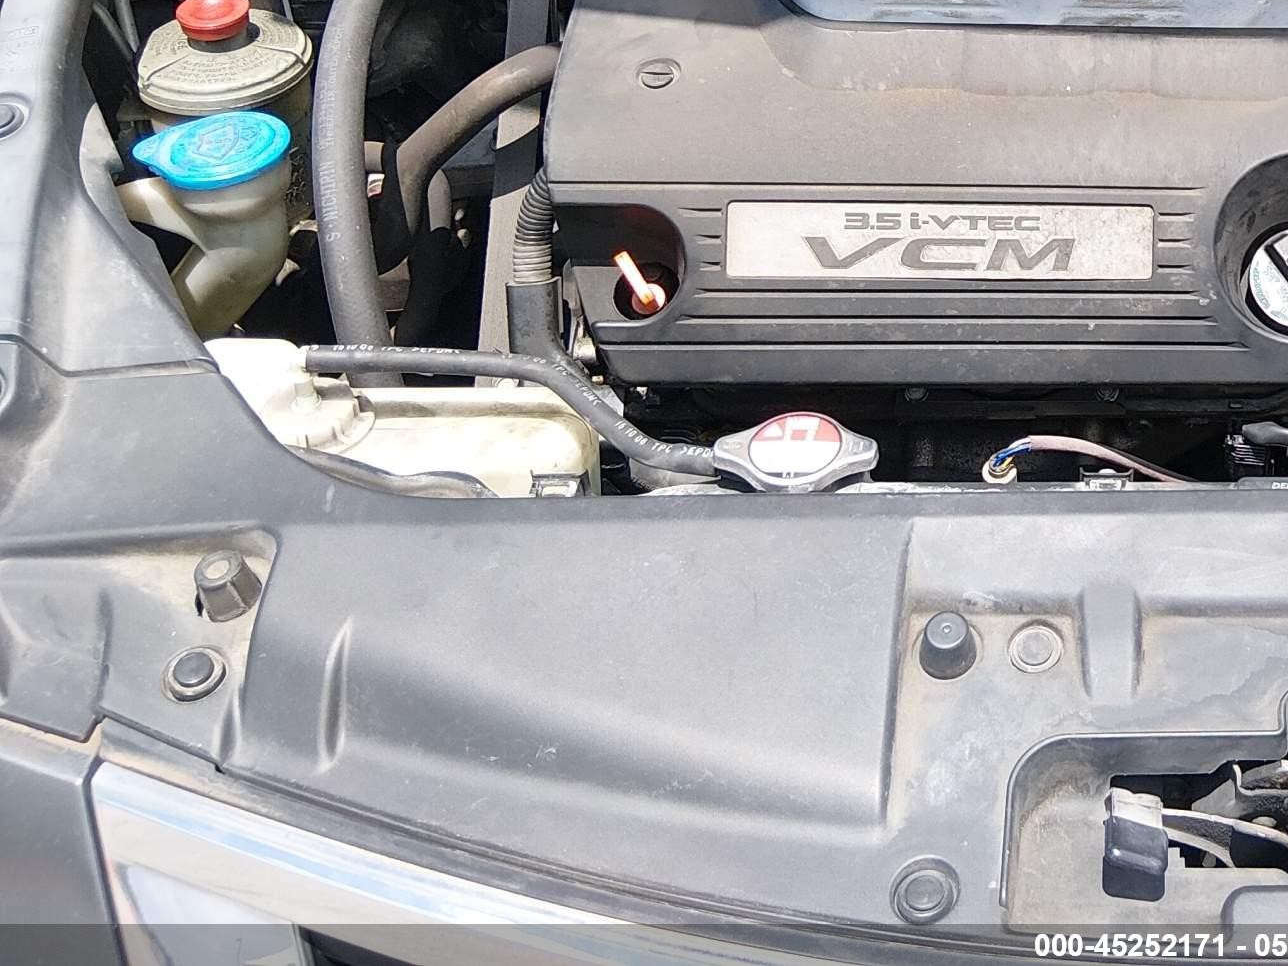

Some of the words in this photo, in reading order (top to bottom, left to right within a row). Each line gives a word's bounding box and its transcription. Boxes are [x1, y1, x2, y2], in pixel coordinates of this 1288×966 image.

[844, 212, 902, 231] 3.5
[910, 212, 1041, 232] i-VTEC
[803, 236, 1075, 272] VCM
